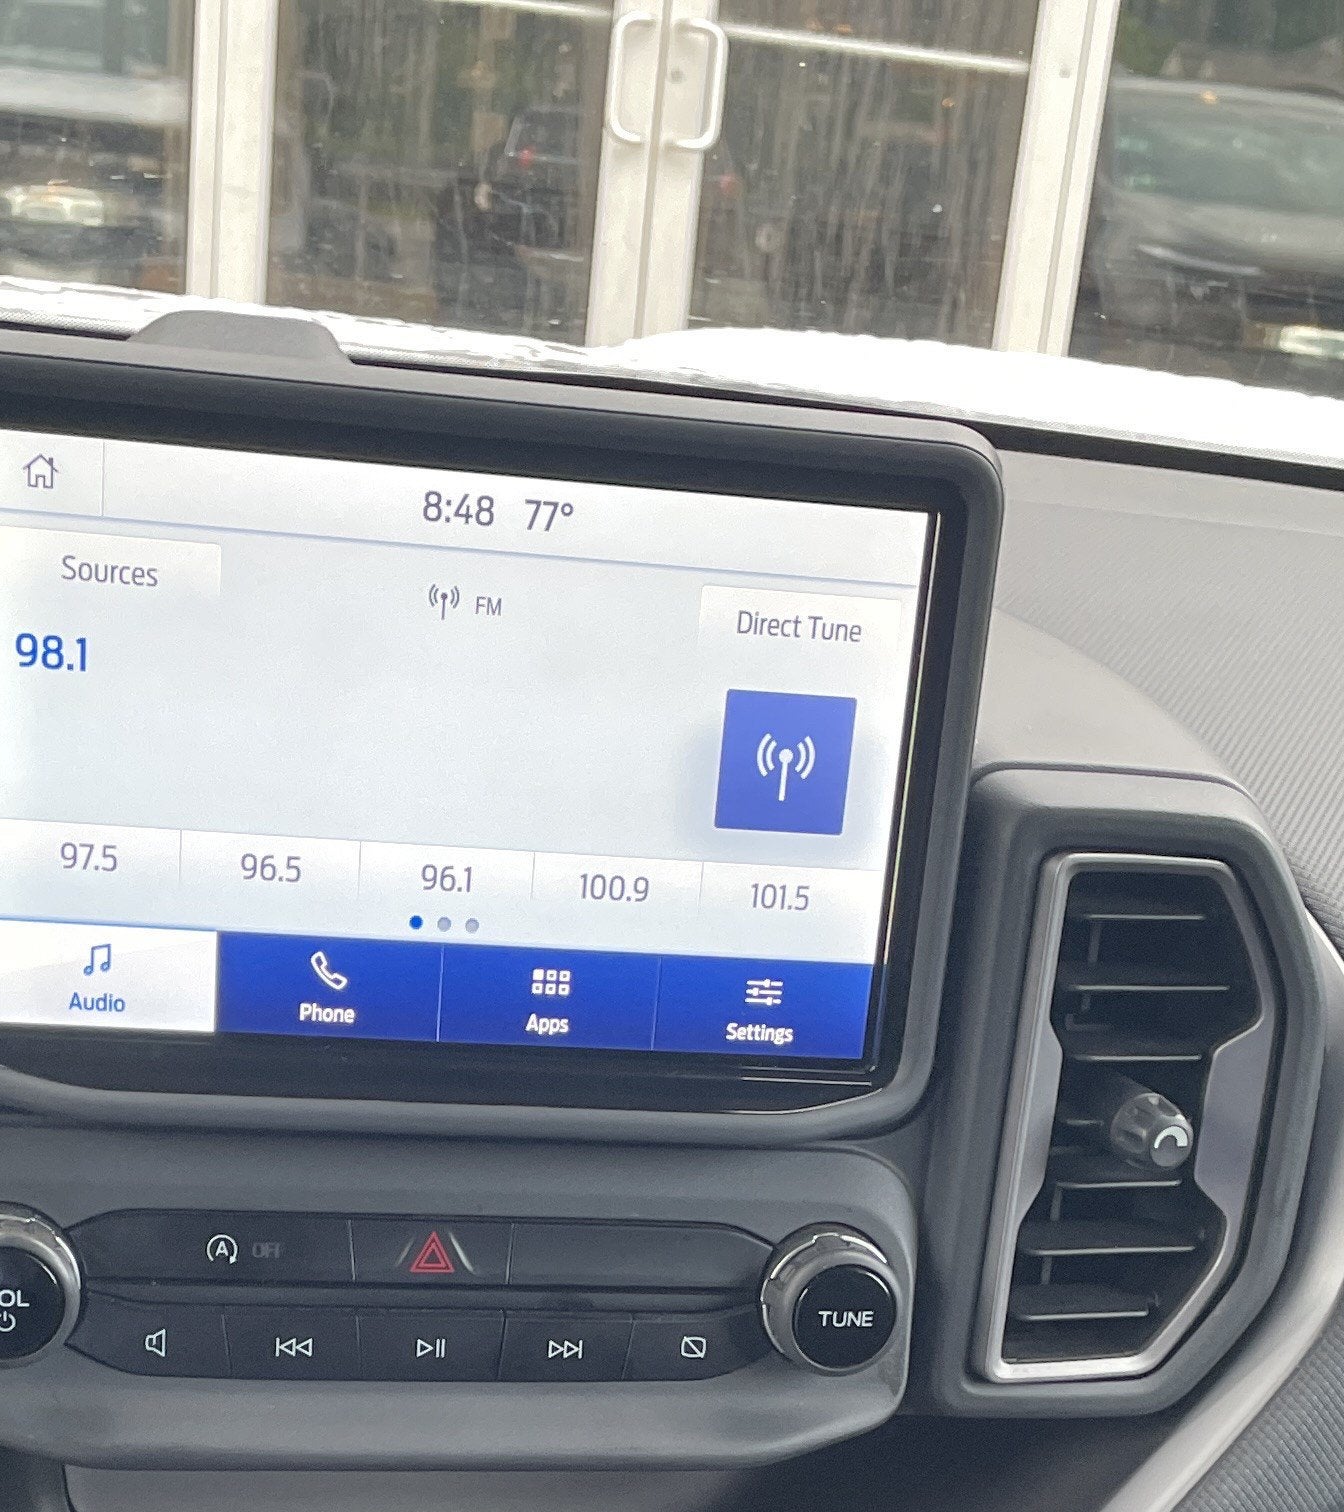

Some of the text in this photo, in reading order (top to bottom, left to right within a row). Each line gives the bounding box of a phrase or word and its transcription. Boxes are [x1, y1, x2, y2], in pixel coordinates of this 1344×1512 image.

[423, 490, 574, 532] 8:48 77°
[61, 554, 158, 587] Sources
[474, 595, 502, 617] FM
[736, 610, 862, 643] Direct Tune
[15, 632, 87, 672] 98.1
[60, 841, 118, 872] 97.5
[240, 853, 302, 883] 96.5
[421, 864, 472, 893] 96.1
[580, 873, 650, 903] 100.9
[751, 883, 810, 911] 101.5
[68, 991, 126, 1013] Audio
[299, 1002, 356, 1024] Phone
[524, 1013, 569, 1036] Apps
[725, 1022, 794, 1046] Settings
[818, 1310, 874, 1328] TUNE
